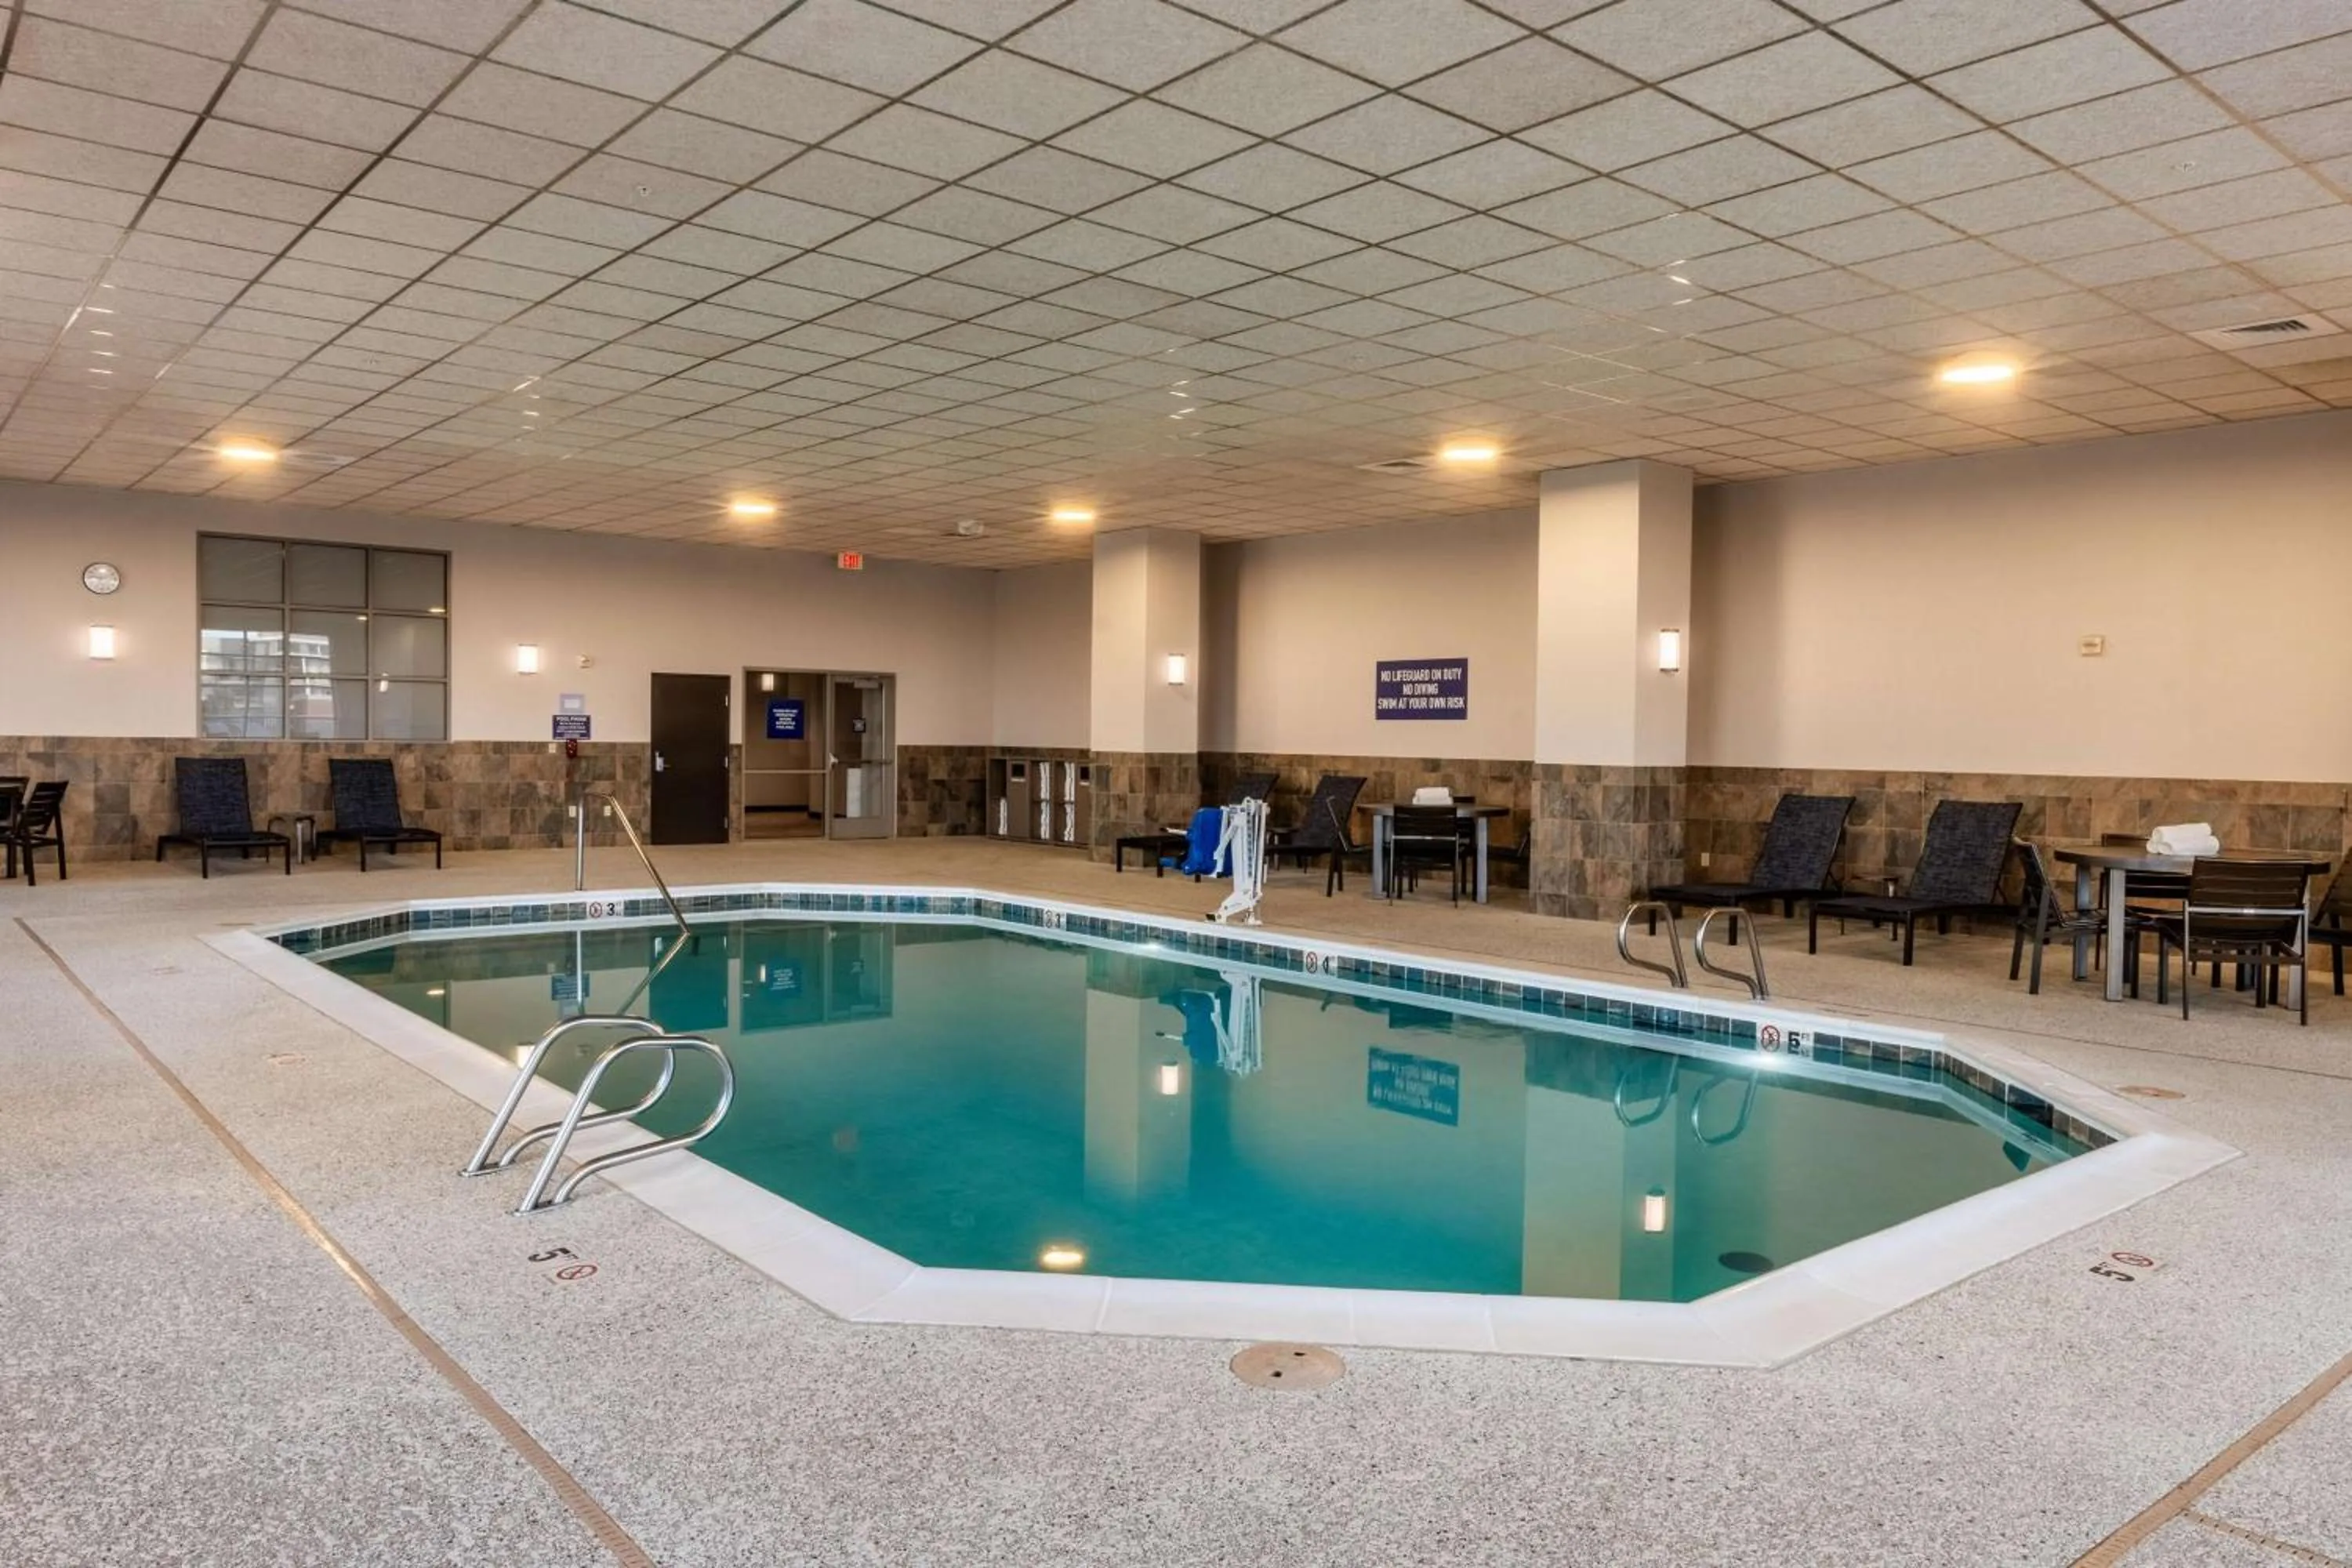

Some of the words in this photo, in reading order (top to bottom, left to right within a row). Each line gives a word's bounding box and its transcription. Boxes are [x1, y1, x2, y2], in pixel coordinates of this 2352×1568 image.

[1381, 670, 1392, 682] NO
[1392, 669, 1430, 681] LIFEGUARD
[1432, 669, 1441, 681] ON
[1443, 667, 1462, 681] DUTY
[1403, 684, 1413, 695] NO
[1414, 683, 1439, 695] DIVING
[1378, 697, 1398, 710] SWIM
[1398, 697, 1408, 710] AT
[1409, 697, 1427, 709] YOUR
[1428, 697, 1446, 709] OWN
[1447, 697, 1465, 710] RISK
[607, 902, 615, 916] 3
[1788, 1031, 1800, 1050] 5
[528, 1247, 571, 1262] 5
[2089, 1266, 2135, 1281] 5
